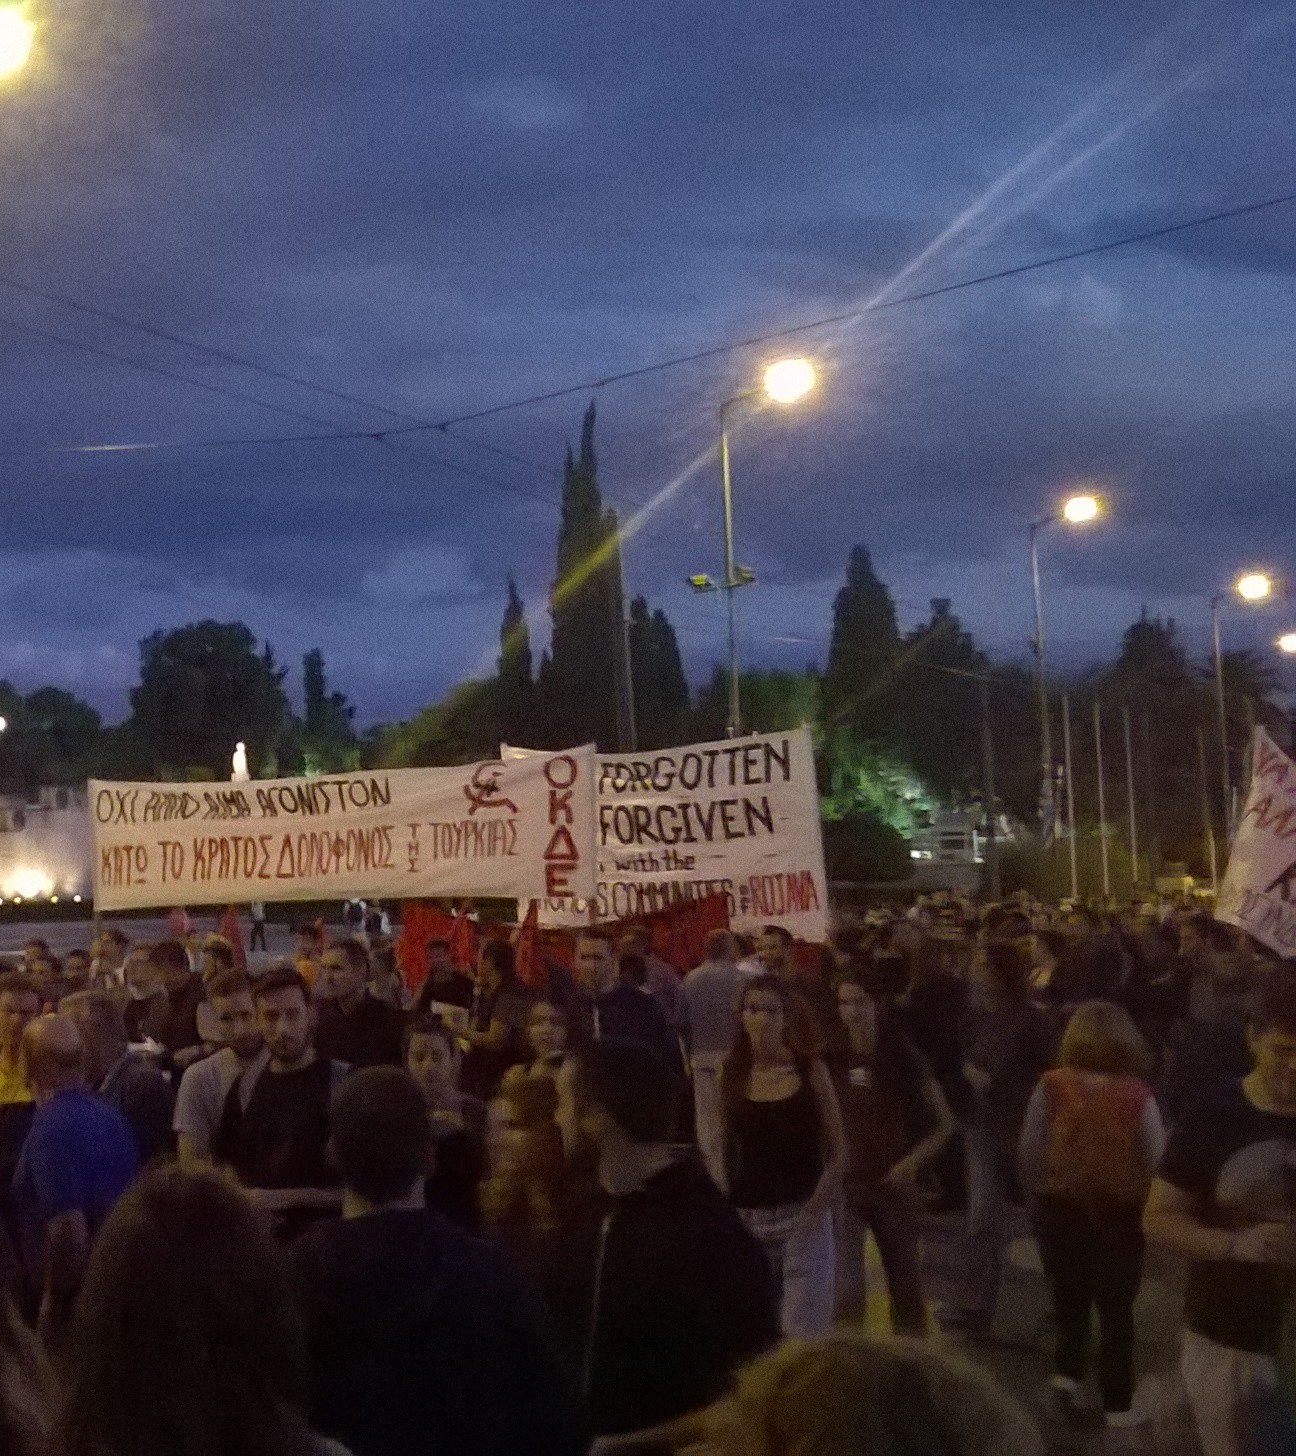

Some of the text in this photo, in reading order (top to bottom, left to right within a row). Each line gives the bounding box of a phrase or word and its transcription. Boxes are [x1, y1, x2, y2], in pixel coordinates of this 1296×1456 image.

[599, 740, 790, 794] FORGOTTEN
[96, 789, 139, 825] ΟΧΙ
[599, 797, 774, 845] FORGIVEN
[157, 841, 184, 883] ΤΟ
[193, 834, 273, 881] ΚΡΑΤΟΣ
[615, 849, 695, 873] with the
